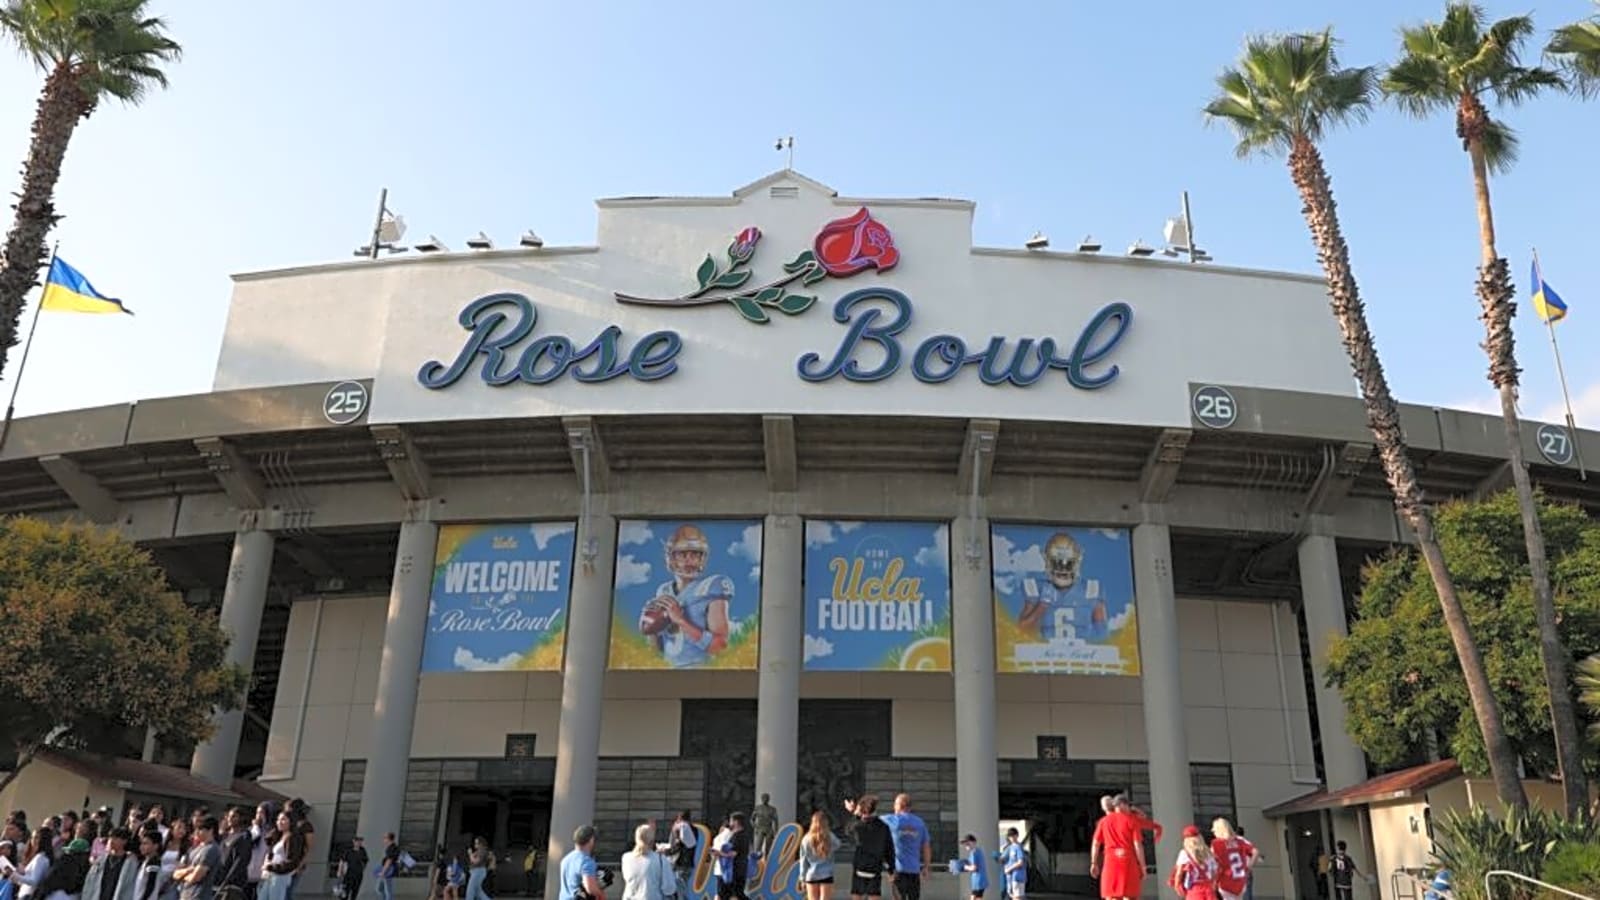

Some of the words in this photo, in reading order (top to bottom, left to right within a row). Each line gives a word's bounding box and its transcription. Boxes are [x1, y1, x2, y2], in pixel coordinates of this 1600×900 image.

[417, 292, 683, 390] Rose
[797, 287, 1134, 390] Bowl
[328, 391, 362, 414] 25
[1199, 395, 1232, 418] 26
[1541, 432, 1566, 454] 27
[445, 560, 560, 593] WELCOME
[828, 557, 925, 603] Ucla
[432, 608, 493, 633] Rose
[490, 607, 561, 632] Bowl
[1054, 608, 1077, 640] 6
[1229, 852, 1246, 879] 2
